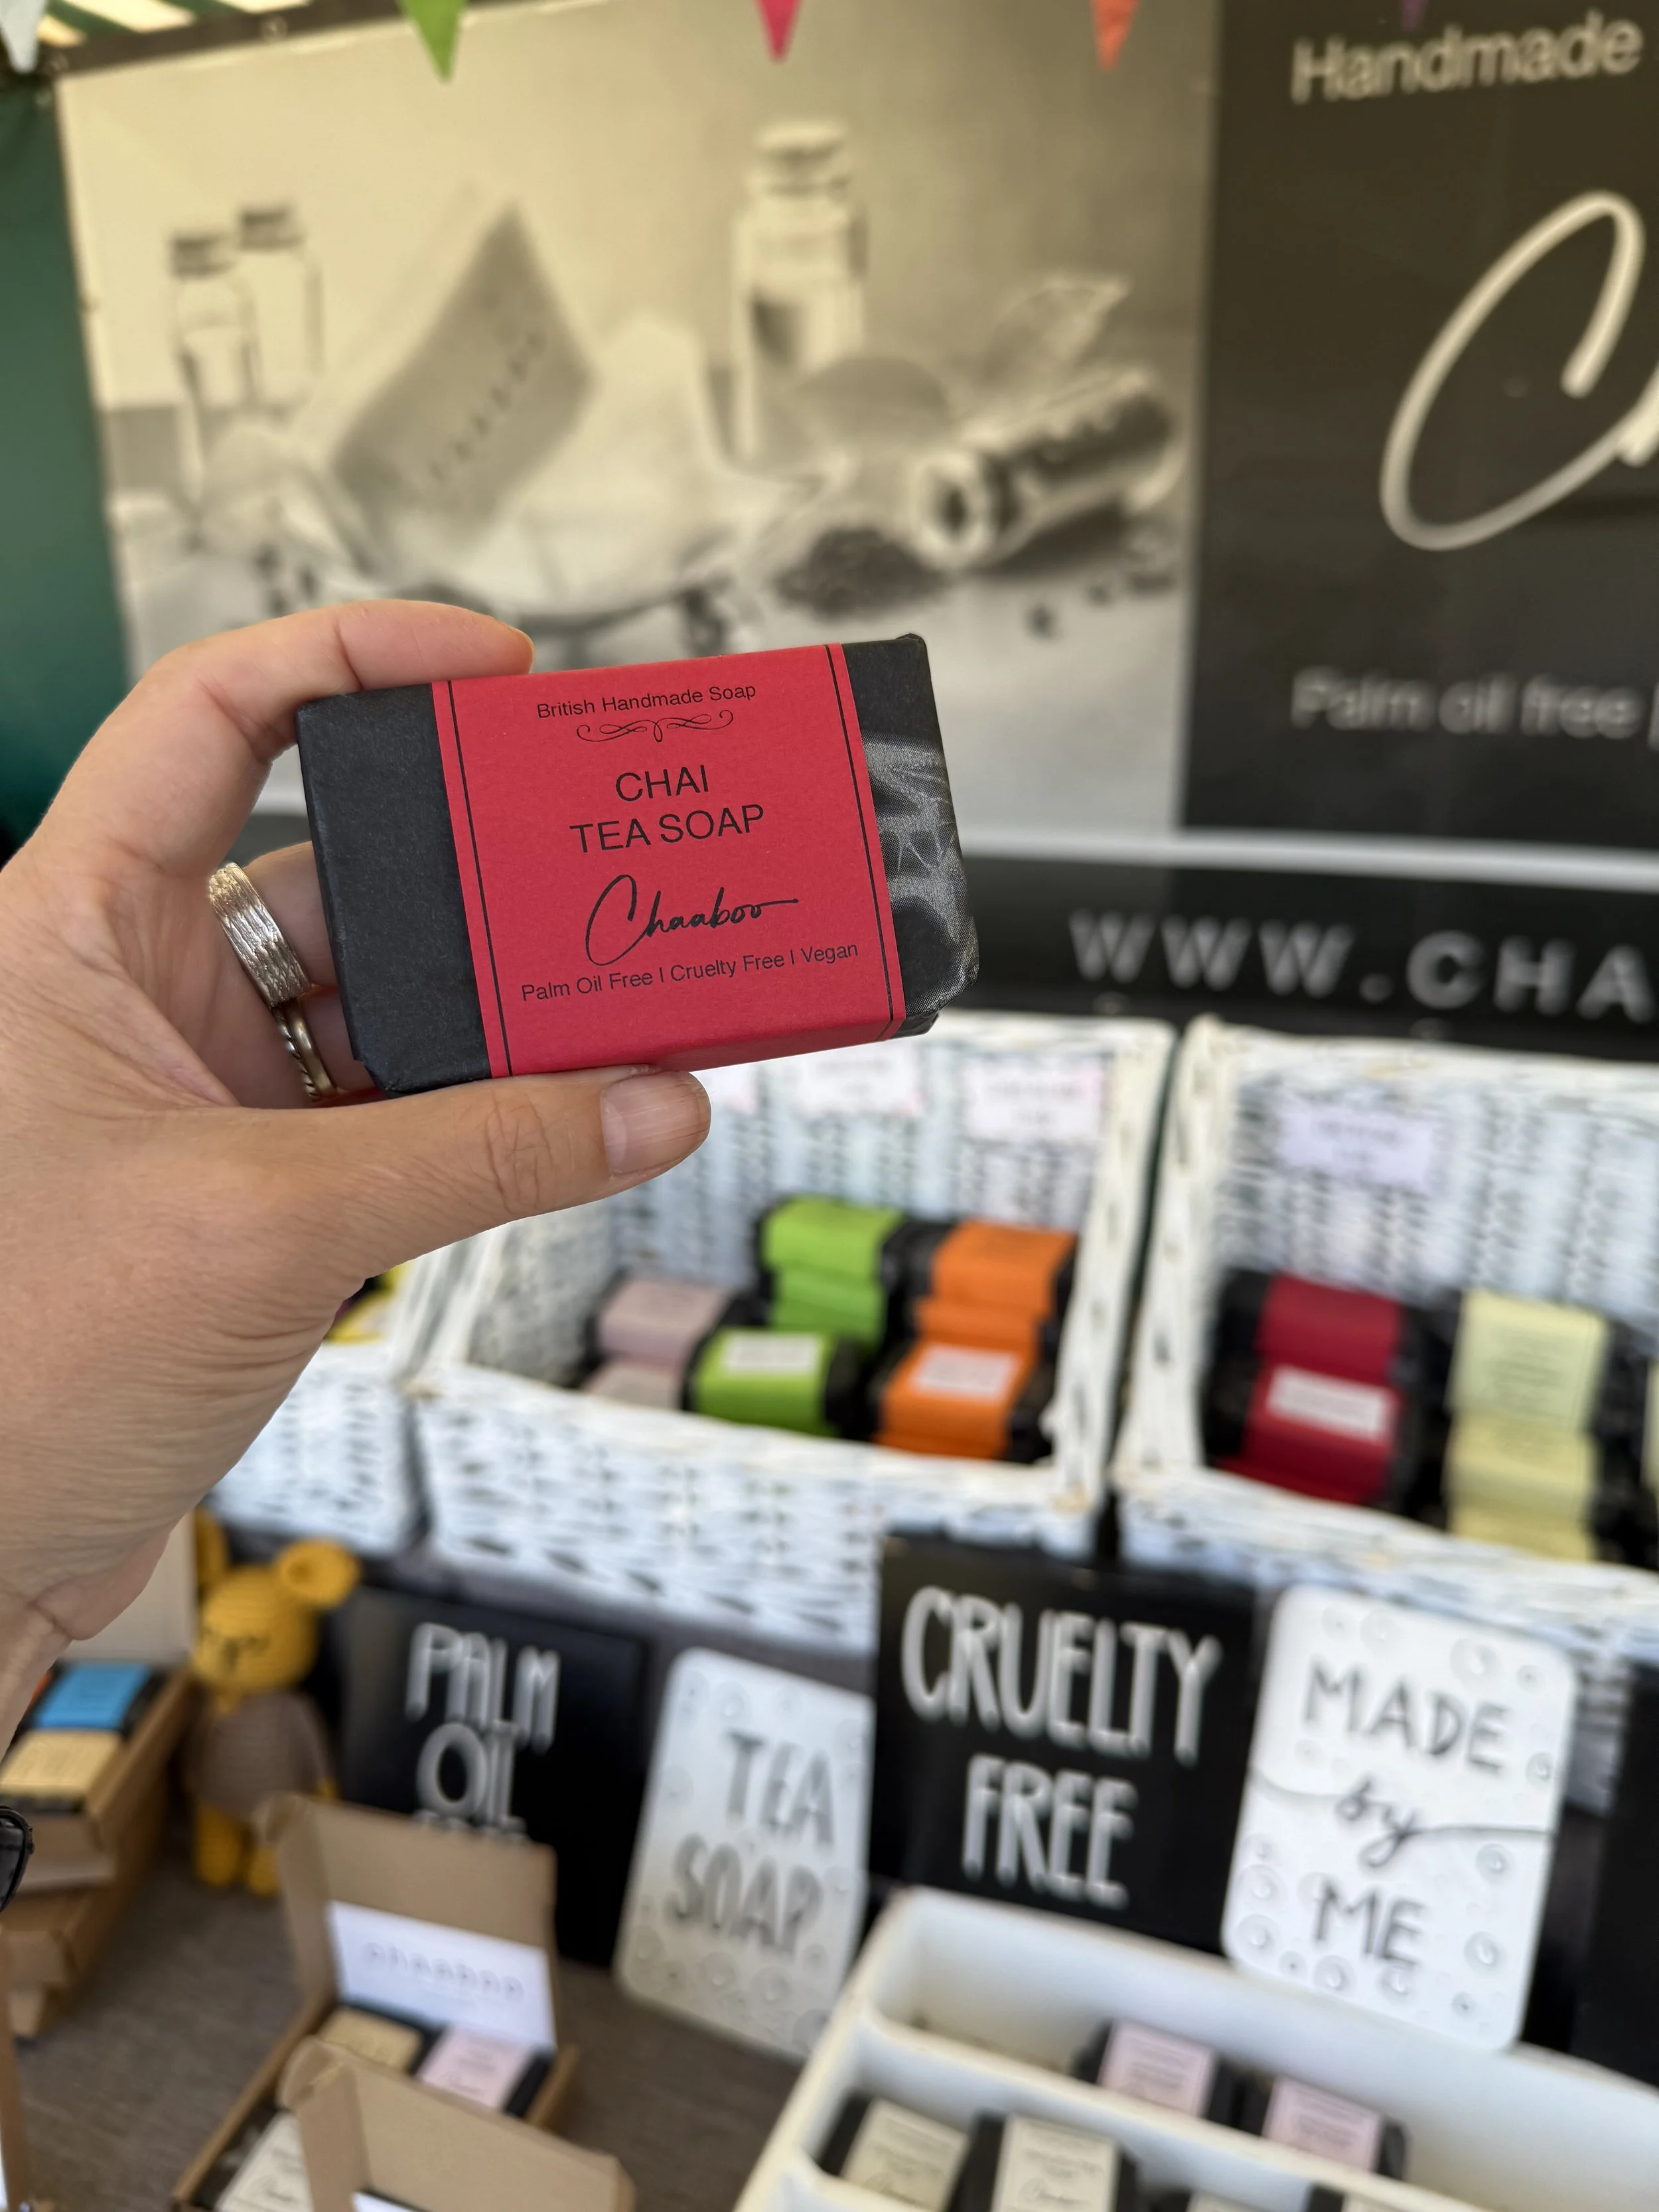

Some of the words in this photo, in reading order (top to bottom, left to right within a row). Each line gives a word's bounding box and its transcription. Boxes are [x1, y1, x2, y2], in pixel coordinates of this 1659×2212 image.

[1291, 9, 1643, 105] Handmade
[537, 699, 595, 719] British
[602, 689, 703, 711] Handmade
[709, 685, 756, 701] Soap
[1291, 666, 1436, 731] Palm
[1439, 670, 1516, 735] oil
[1520, 672, 1644, 739] free
[569, 818, 651, 853] TEA
[658, 804, 764, 844] SOAP
[615, 765, 709, 802] CHAI
[585, 874, 799, 966] Chaaboo
[522, 982, 570, 1001] Palm
[576, 974, 603, 995] Oil
[609, 972, 654, 991] Free
[670, 958, 737, 982] Cruelty
[743, 954, 785, 972] Free
[800, 942, 859, 964] Vegan
[405, 1621, 561, 1753] PALM
[901, 1585, 1223, 1767] CRUELTY
[1302, 1661, 1513, 1776] MADE
[726, 1728, 836, 1850] TEA
[960, 1750, 1139, 1909] FREE
[672, 1832, 824, 1955] SOAP
[1309, 1877, 1426, 1971] ME
